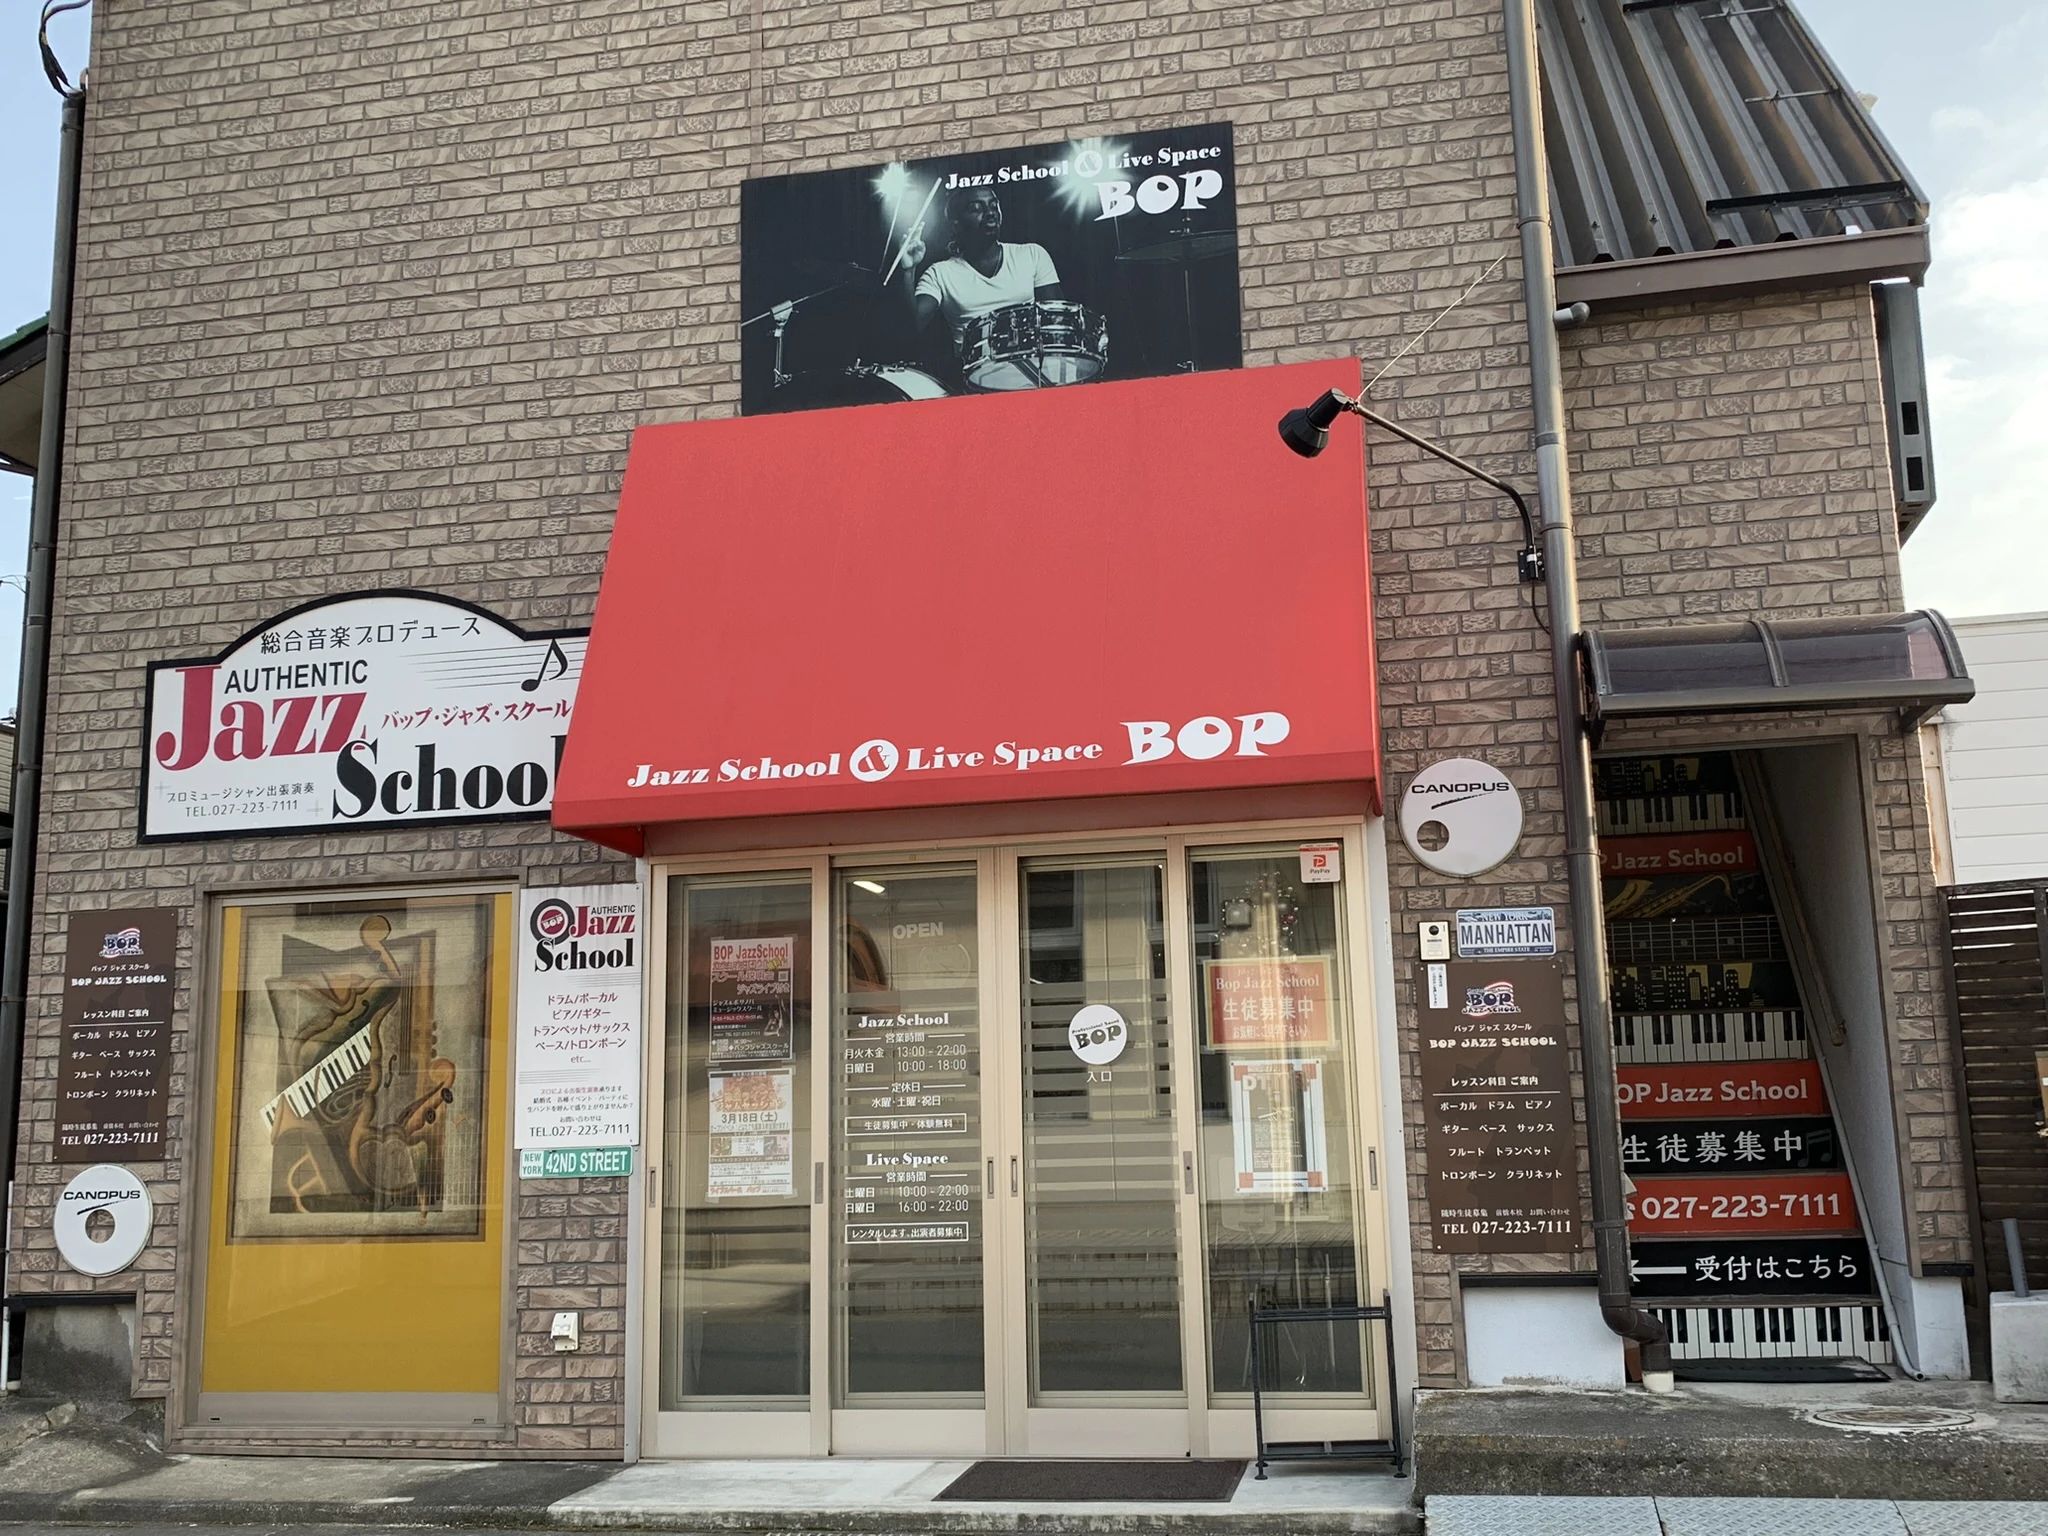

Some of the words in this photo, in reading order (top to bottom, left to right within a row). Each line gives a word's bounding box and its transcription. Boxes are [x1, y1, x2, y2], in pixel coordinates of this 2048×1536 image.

[945, 173, 994, 190] Jazz
[998, 160, 1068, 184] School
[1108, 153, 1153, 170] Live
[1157, 146, 1222, 167] Space
[1094, 169, 1223, 222] BOP
[260, 616, 481, 656] 総合音楽プロデュース
[224, 660, 368, 694] AUTHENTIC
[156, 665, 368, 771] Jazz
[381, 699, 572, 730] バップ・ジャズ・スクール
[627, 764, 710, 787] Jazz
[717, 753, 841, 783] School
[854, 742, 894, 778] &
[904, 746, 984, 771] Live
[993, 741, 1103, 771] Space
[1120, 711, 1290, 766] BOP
[167, 782, 315, 803] プロミュージシャン出張演奏
[1411, 782, 1509, 794] CANOPUS
[1611, 852, 1662, 870] Jazz
[1668, 846, 1744, 867] School
[591, 905, 636, 915] AUTHENTIC
[569, 905, 635, 938] Jazz
[893, 921, 943, 939] OPEN
[1461, 923, 1551, 945] MANHATTAN
[107, 937, 138, 949] BOP
[535, 937, 634, 972] School
[714, 946, 733, 960] BOP
[736, 943, 788, 959] JazzSchool
[71, 978, 92, 986] BOP
[95, 977, 123, 985] JAZZ
[125, 974, 167, 984] SCHOOL
[1216, 978, 1240, 992] Bop
[1277, 974, 1320, 988] School
[1470, 992, 1512, 1006] BOP
[1223, 995, 1313, 1021] 生徒募集中
[858, 1016, 894, 1028] Jazz
[897, 1013, 949, 1026] School
[1504, 1023, 1532, 1031] スクール
[108, 1030, 129, 1039] ドラム
[885, 1032, 925, 1043] 営業時間
[1074, 1025, 1121, 1050] BOP
[1429, 1039, 1456, 1048] BOP
[1461, 1038, 1497, 1048] JAZZ
[1502, 1037, 1556, 1047] SCHOOL
[71, 1051, 92, 1060] ギター
[128, 1049, 156, 1057] サックス
[845, 1047, 884, 1059] 月火木金
[897, 1046, 925, 1057] 13:00
[937, 1044, 966, 1056] 22:00
[845, 1062, 874, 1073] 日曜日
[898, 1060, 925, 1072] 10:00
[938, 1059, 966, 1070] 18:00
[74, 1070, 102, 1079] フルート
[1087, 1071, 1112, 1083] 入口
[1451, 1076, 1506, 1087] レッスン科目
[1511, 1076, 1538, 1086] ご案内
[891, 1082, 920, 1093] 定休日
[1616, 1083, 1651, 1104] OP
[1655, 1082, 1714, 1103] Jazz
[1720, 1079, 1808, 1102] School
[1440, 1101, 1477, 1111] ボーカル
[1488, 1101, 1515, 1110] ドラム
[1442, 1124, 1469, 1134] ギター
[1479, 1124, 1507, 1133] ベース
[1517, 1123, 1555, 1132] サックス
[61, 1136, 81, 1145] TEL
[83, 1132, 159, 1145] 027-223-7111
[1448, 1147, 1485, 1157] フルート
[1496, 1146, 1551, 1156] トランペット
[1622, 1130, 1802, 1164] 生徒募集中
[524, 1153, 542, 1162] NEW
[545, 1151, 577, 1173] 42ND
[580, 1150, 628, 1172] STREET
[866, 1153, 899, 1166] Live
[902, 1152, 949, 1168] Space
[522, 1165, 543, 1175] YORK
[886, 1171, 926, 1183] 営業時間
[1441, 1170, 1496, 1180] トロンボーン
[1507, 1169, 1562, 1179] クラリネット
[63, 1190, 141, 1200] CANOPUS
[845, 1187, 875, 1198] 土曜日
[899, 1185, 926, 1197] 10:00
[938, 1184, 968, 1196] 22:00
[845, 1202, 875, 1214] 日曜日
[899, 1201, 926, 1212] 16:00
[938, 1200, 968, 1212] 22:00
[1641, 1193, 1841, 1220] 027-223-7111
[1441, 1223, 1469, 1234] TEL
[1472, 1220, 1571, 1234] 027-223-7111
[1695, 1254, 1858, 1282] 受付はこちら
